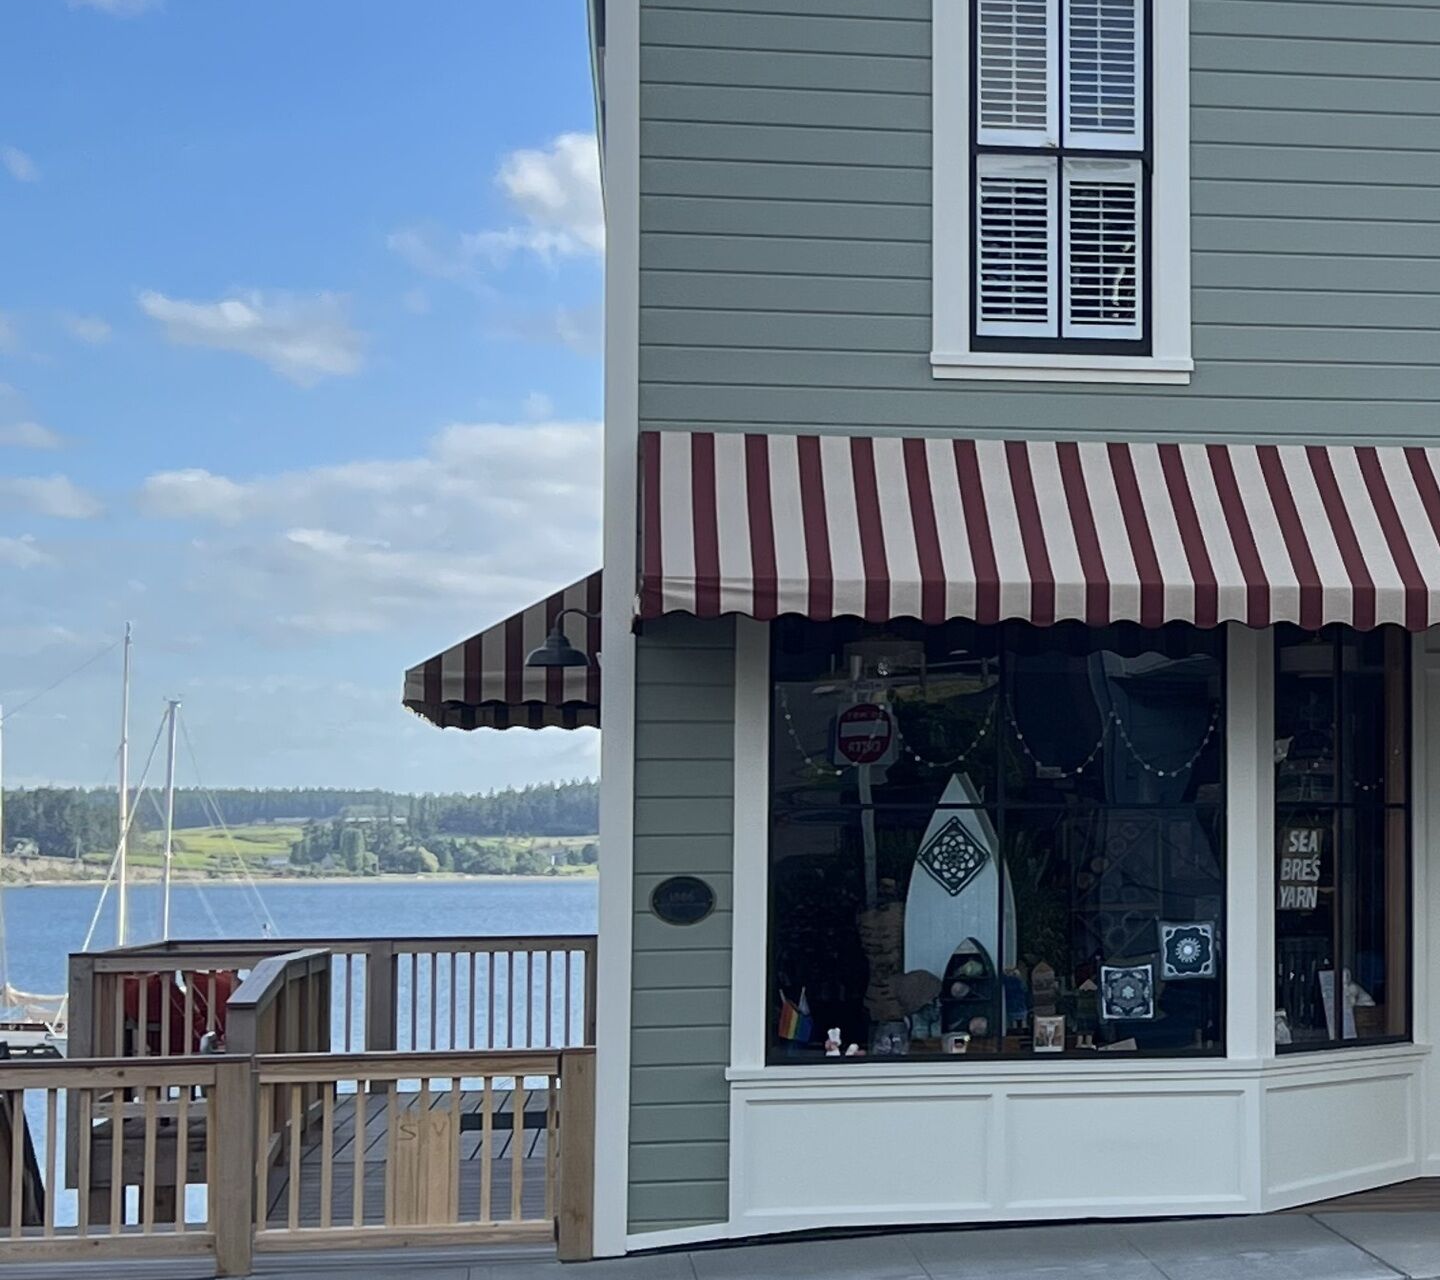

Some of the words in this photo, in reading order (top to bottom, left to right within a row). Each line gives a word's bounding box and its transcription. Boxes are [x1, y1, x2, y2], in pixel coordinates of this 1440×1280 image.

[1288, 830, 1318, 853] SEA
[1280, 854, 1321, 882] BRE'S
[1279, 885, 1319, 909] YARN
